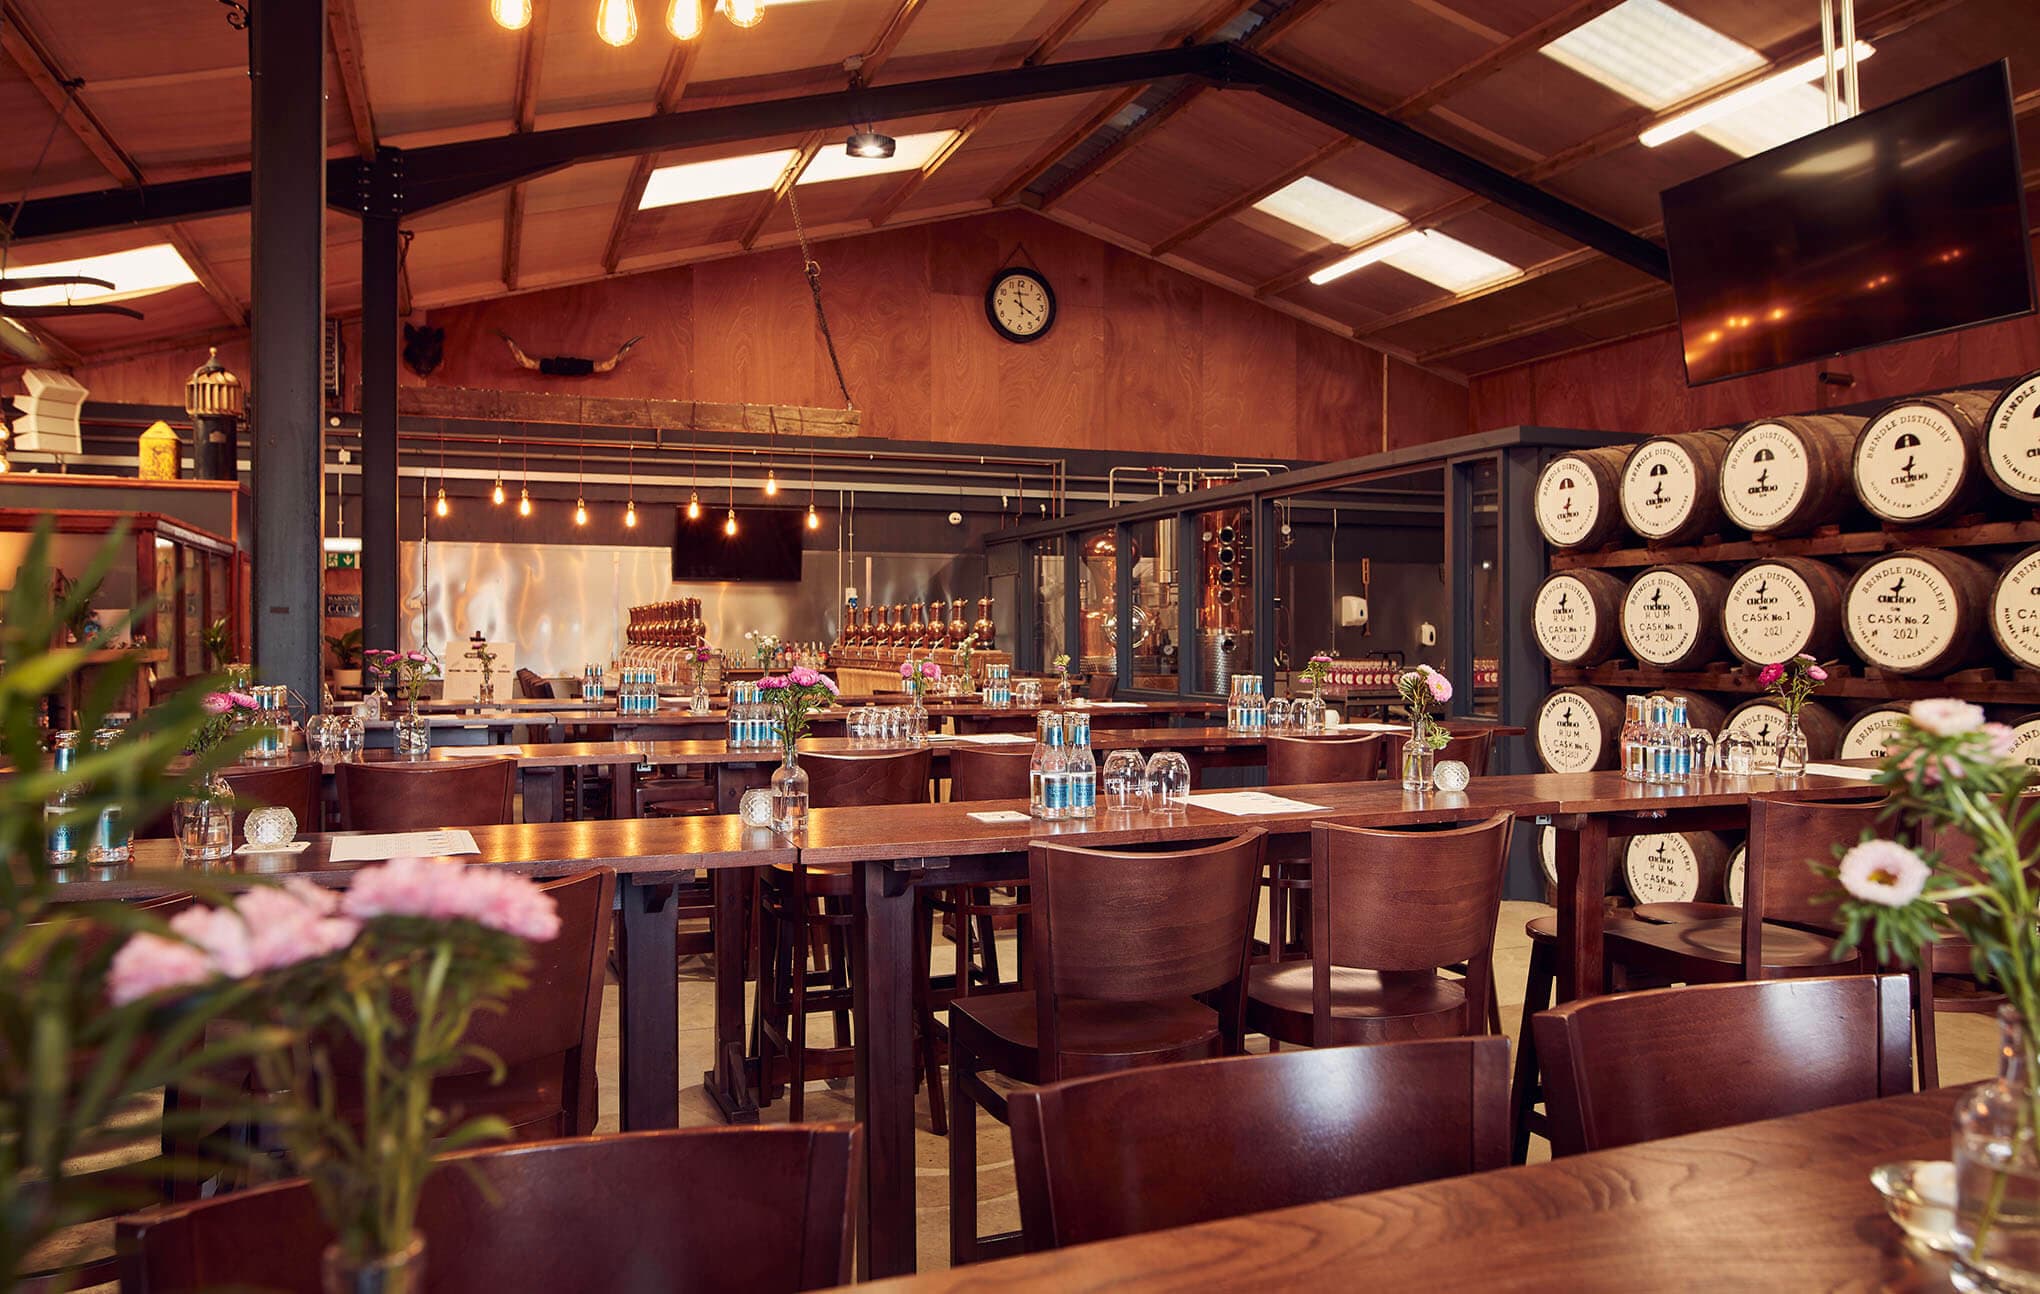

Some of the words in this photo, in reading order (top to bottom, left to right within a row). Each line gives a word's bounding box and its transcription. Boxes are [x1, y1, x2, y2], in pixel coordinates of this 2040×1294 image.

[1999, 385, 2036, 430] BRINDLE
[1866, 419, 1898, 459] BRINDLE
[1900, 415, 1952, 443] DISTILLERY
[1730, 435, 1757, 470] BRINDLE
[1759, 431, 1800, 460] DISTILLERY
[1630, 451, 1653, 483] BRINDLE
[1654, 447, 1689, 475] DISTILLERY
[2002, 454, 2025, 480] HOLMES
[1543, 467, 1561, 497] BRINDLE
[1561, 463, 1593, 487] DISTILLERY
[1541, 582, 1563, 605] BRINDLE
[1564, 582, 1591, 616] DISTILLERY
[1630, 579, 1656, 605] BRINDLE
[1657, 578, 1692, 612] DISTILLERY
[1733, 572, 1763, 602] BRINDLE
[1766, 571, 1806, 608] DISTILLERY
[1862, 566, 1902, 594] BRINDLE
[1905, 567, 1947, 612] DISTILLERY
[1553, 614, 1574, 622] RUM
[1639, 623, 1663, 631] CASK
[1645, 610, 1671, 619] RUM
[1742, 613, 1770, 622] CASK
[1786, 611, 1791, 621] 1
[1867, 614, 1901, 624] CASK
[1922, 614, 1930, 625] 2
[2004, 607, 2019, 640] HOLMES
[1548, 625, 1568, 634] CASK
[1655, 632, 1673, 643] 2021
[1764, 626, 1783, 637] 2021
[1893, 627, 1919, 640] 2021
[1545, 695, 1567, 718] BRINDLE
[1568, 696, 1595, 730] DISTILLERY
[1553, 739, 1574, 749] CASK
[1559, 729, 1580, 738] RUM
[1856, 719, 1893, 746] BRINDLE
[2008, 729, 2040, 754] BRIND
[1643, 872, 1666, 884] CASK
[1649, 862, 1674, 873] RUM
